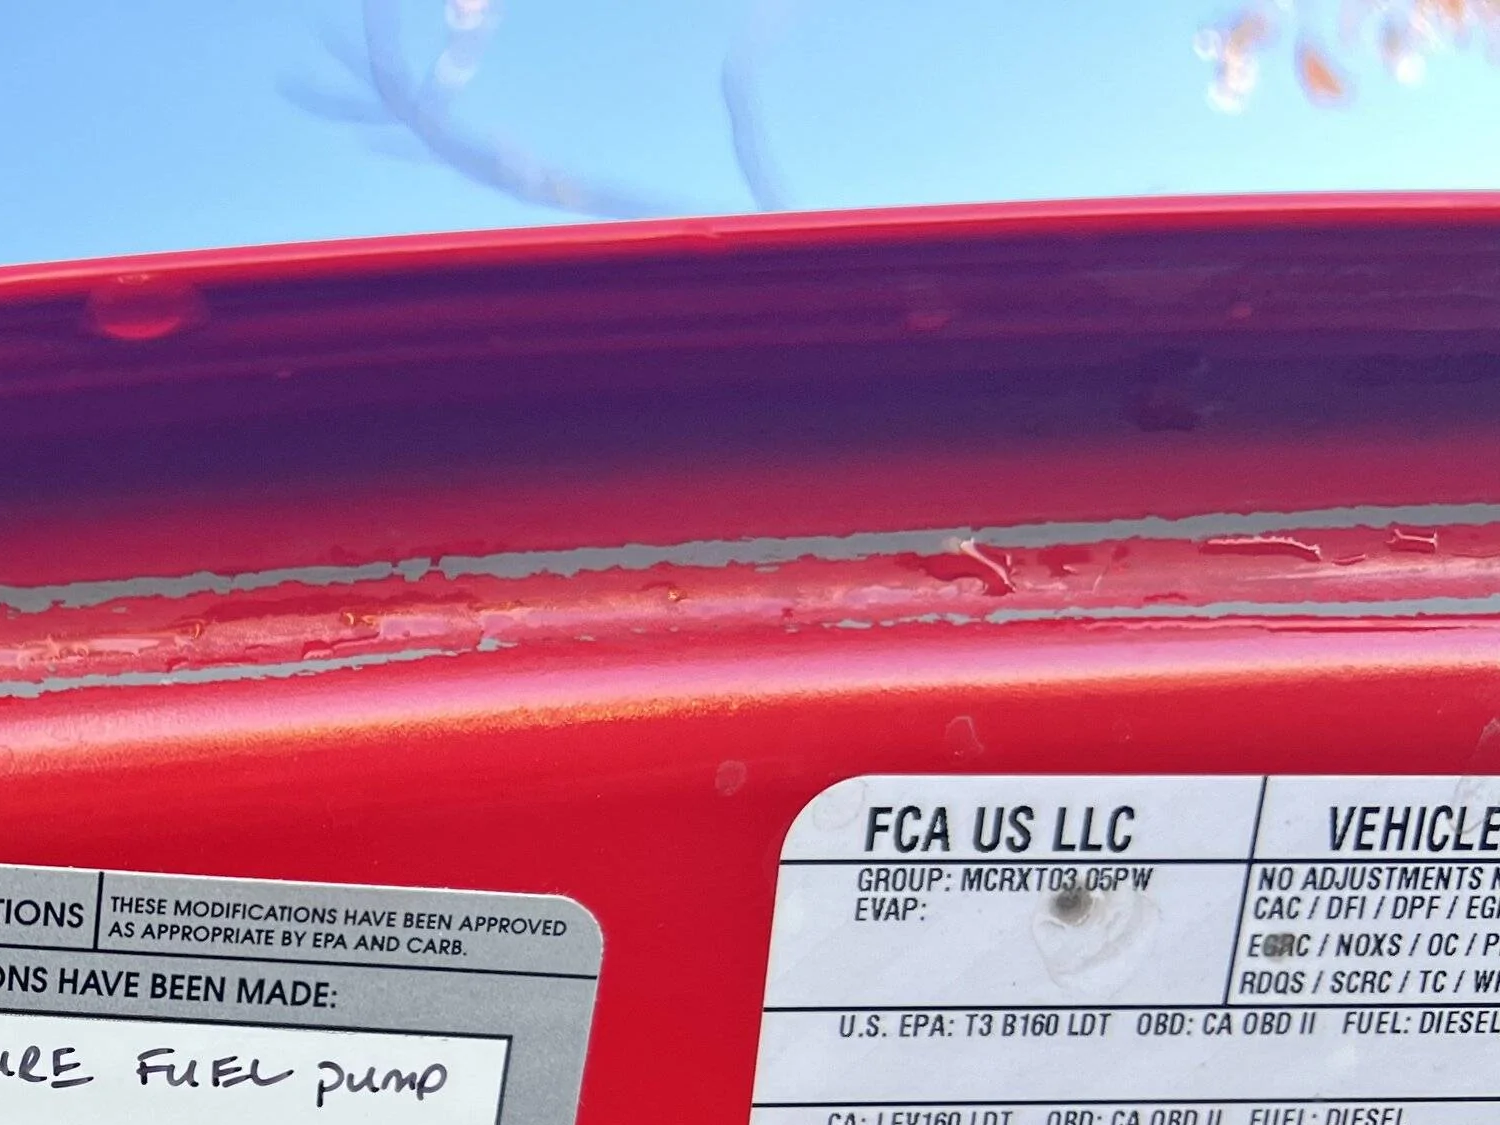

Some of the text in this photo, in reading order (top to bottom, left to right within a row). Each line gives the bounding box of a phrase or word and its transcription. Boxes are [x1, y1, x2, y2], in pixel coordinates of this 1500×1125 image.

[865, 805, 1135, 853] FCA US LLC
[1331, 805, 1500, 852] VEHICLE
[858, 866, 1154, 893] GROUP: MCRXT03.05PW
[1258, 867, 1294, 890] NO
[1300, 867, 1483, 890] ADJUSTMENTS
[111, 896, 567, 936] THESE MODIFICATIONS HAVE BEEN APPROVED
[855, 897, 926, 921] EVAP:
[1254, 896, 1301, 919] CAC
[1327, 896, 1366, 919] DFI
[1392, 896, 1441, 919] DPF
[108, 921, 466, 955] AS APPROPRIATE BY EPA AND CARB.
[1336, 934, 1403, 956] NOXS
[1428, 933, 1459, 956] OC
[58, 968, 140, 998] HAVE
[150, 973, 225, 1002] BEEN
[237, 978, 337, 1008] MADE:
[1239, 971, 1305, 995] RDQS
[1330, 971, 1392, 993] SCRC
[1420, 970, 1447, 993] TC
[840, 1011, 1500, 1037] U.S. EPA: T3 B160 LDT OBD: CA OBD II FUEL: DIESEL
[136, 1048, 294, 1088] FUEL
